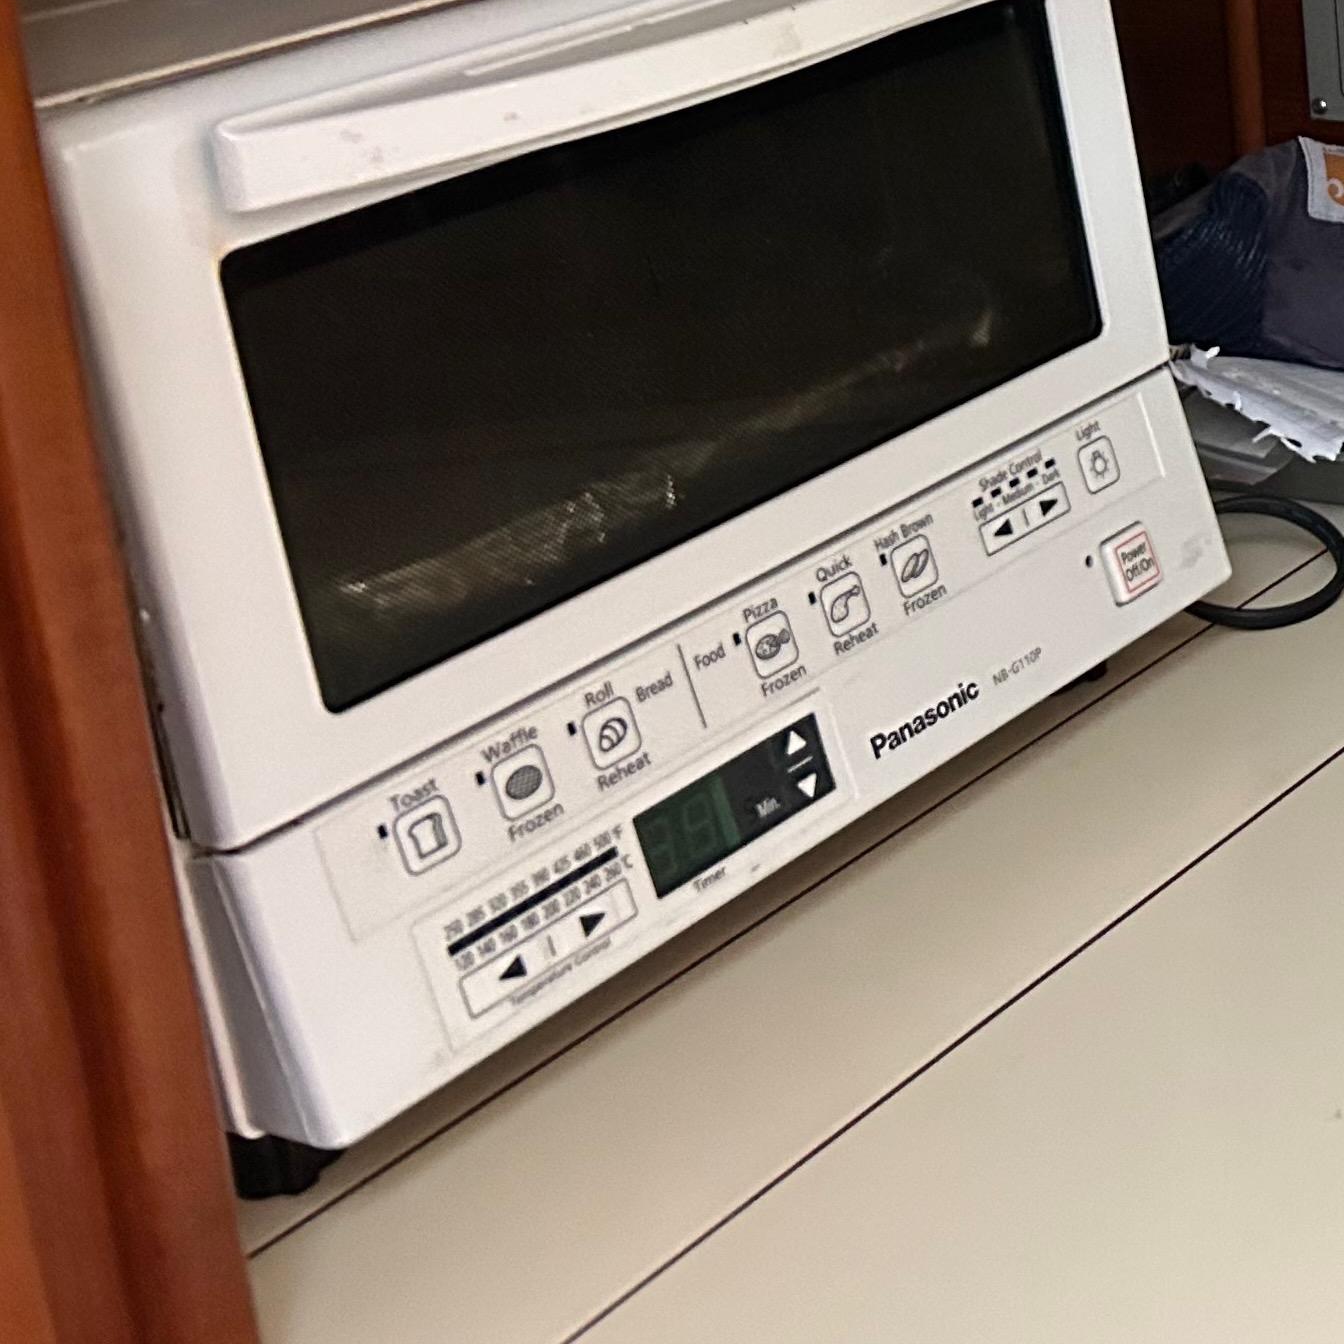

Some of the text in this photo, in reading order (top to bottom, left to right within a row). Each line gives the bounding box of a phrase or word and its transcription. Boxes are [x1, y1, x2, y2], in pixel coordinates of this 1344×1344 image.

[1075, 420, 1101, 441] Light
[978, 447, 1043, 492] Shade Control
[873, 512, 934, 552] Hash Brown
[816, 555, 853, 584] Quick
[1121, 542, 1147, 564] Power
[743, 595, 780, 623] Pizza
[903, 582, 948, 616] Frozen
[833, 620, 880, 656] Reheat
[694, 645, 727, 670] Food
[585, 682, 615, 708] Roll
[635, 673, 675, 703] Bread
[760, 664, 808, 698] Frozen
[869, 680, 982, 759] Panasonic
[481, 725, 540, 764] Waffle
[597, 753, 653, 792] Reheat
[389, 778, 439, 812] Toast
[507, 803, 566, 843] Frozen
[693, 865, 728, 893] Timer
